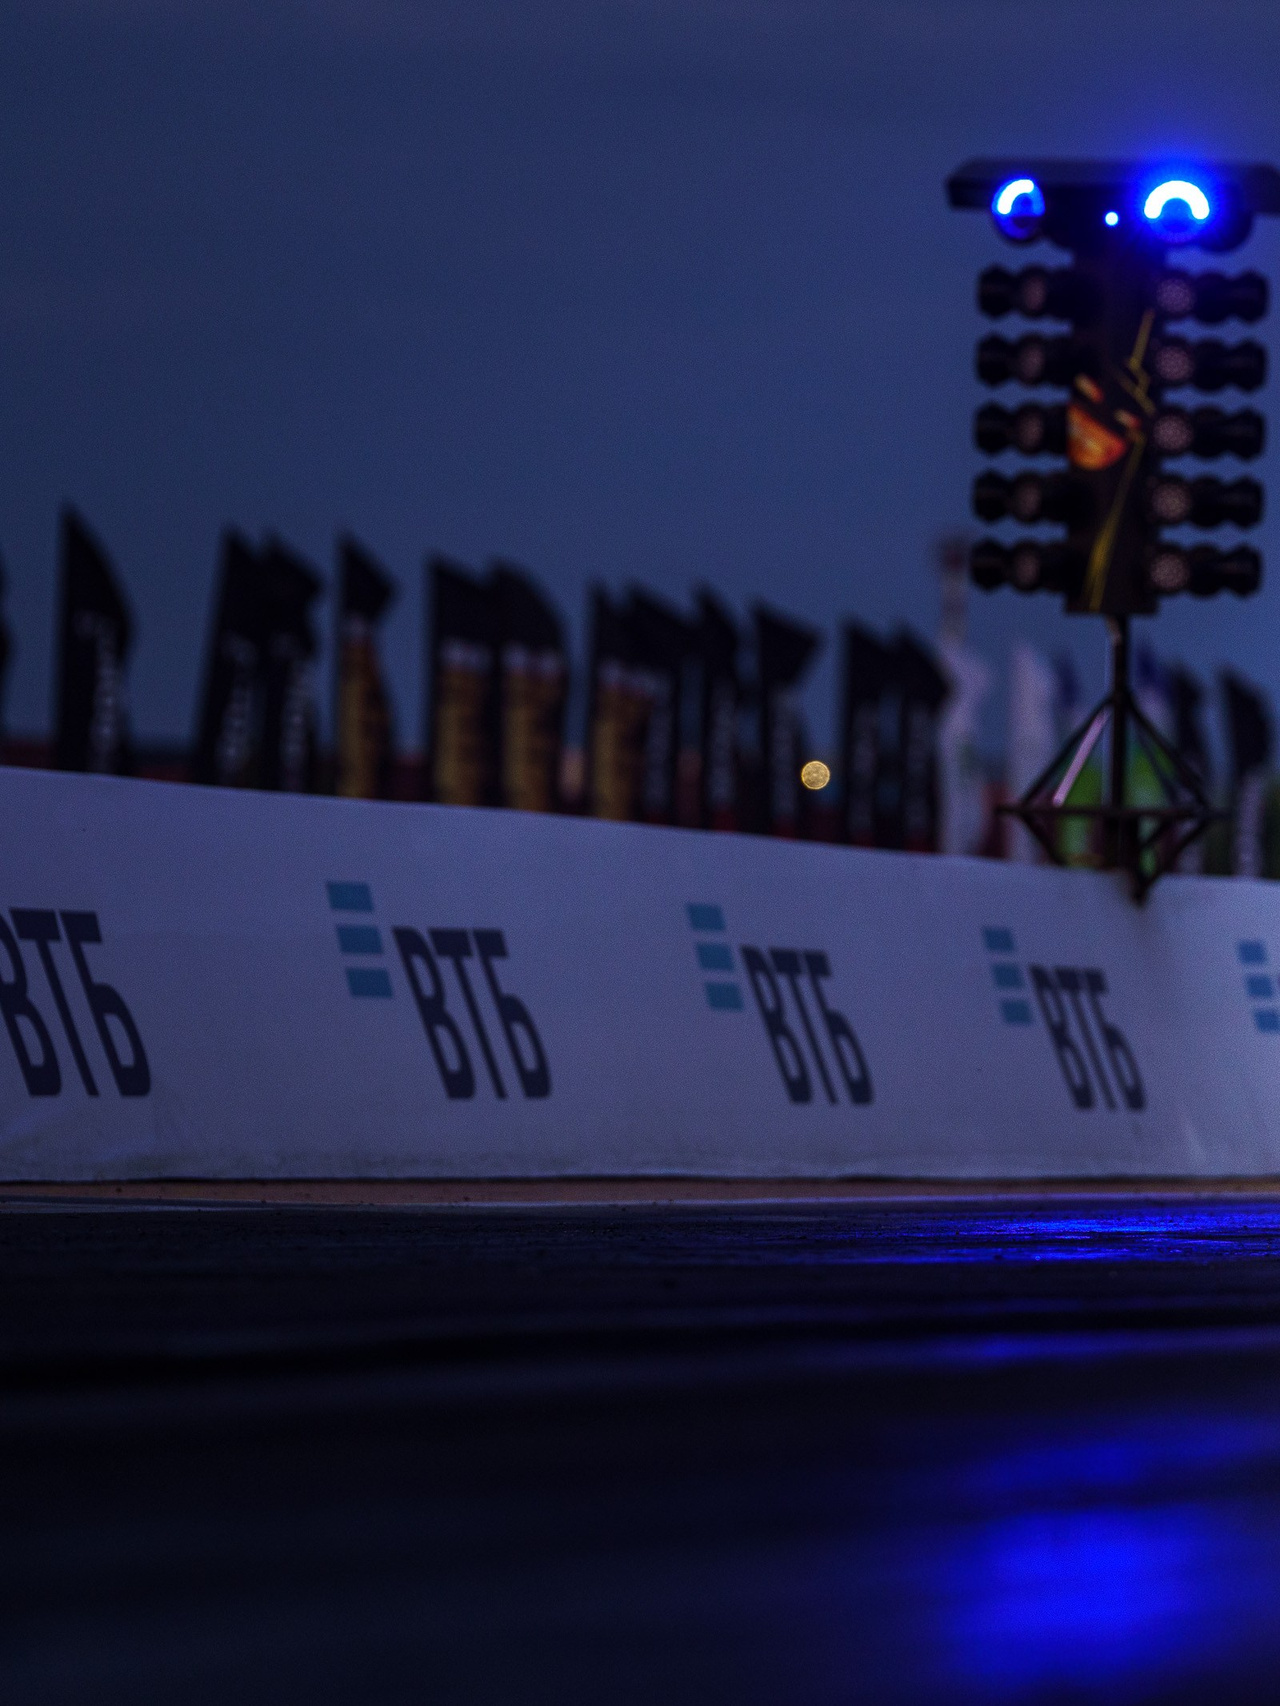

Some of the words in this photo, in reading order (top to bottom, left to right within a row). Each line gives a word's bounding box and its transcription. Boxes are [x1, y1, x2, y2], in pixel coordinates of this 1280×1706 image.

[0, 907, 151, 1097] ВТБ
[392, 925, 551, 1099] ВТБ
[740, 945, 874, 1105] ВТБ
[1029, 964, 1146, 1110] ВТБ
